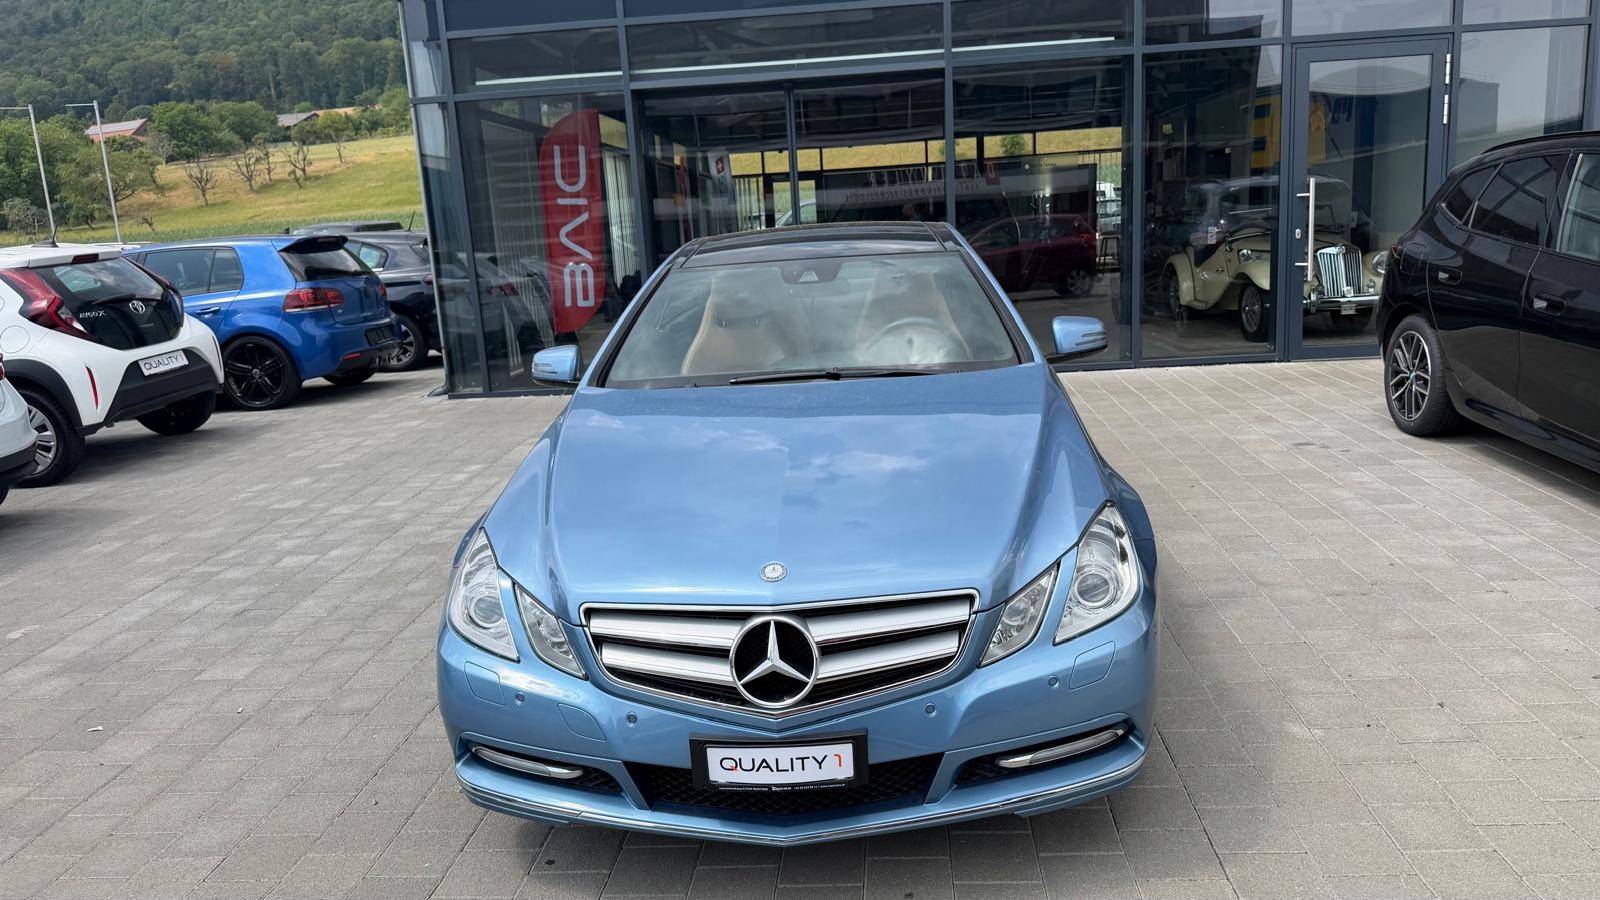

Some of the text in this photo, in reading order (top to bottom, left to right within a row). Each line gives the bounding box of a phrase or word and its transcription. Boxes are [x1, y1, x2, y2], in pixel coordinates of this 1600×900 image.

[144, 355, 179, 370] QUALITY
[719, 753, 843, 773] QUALITY 1
